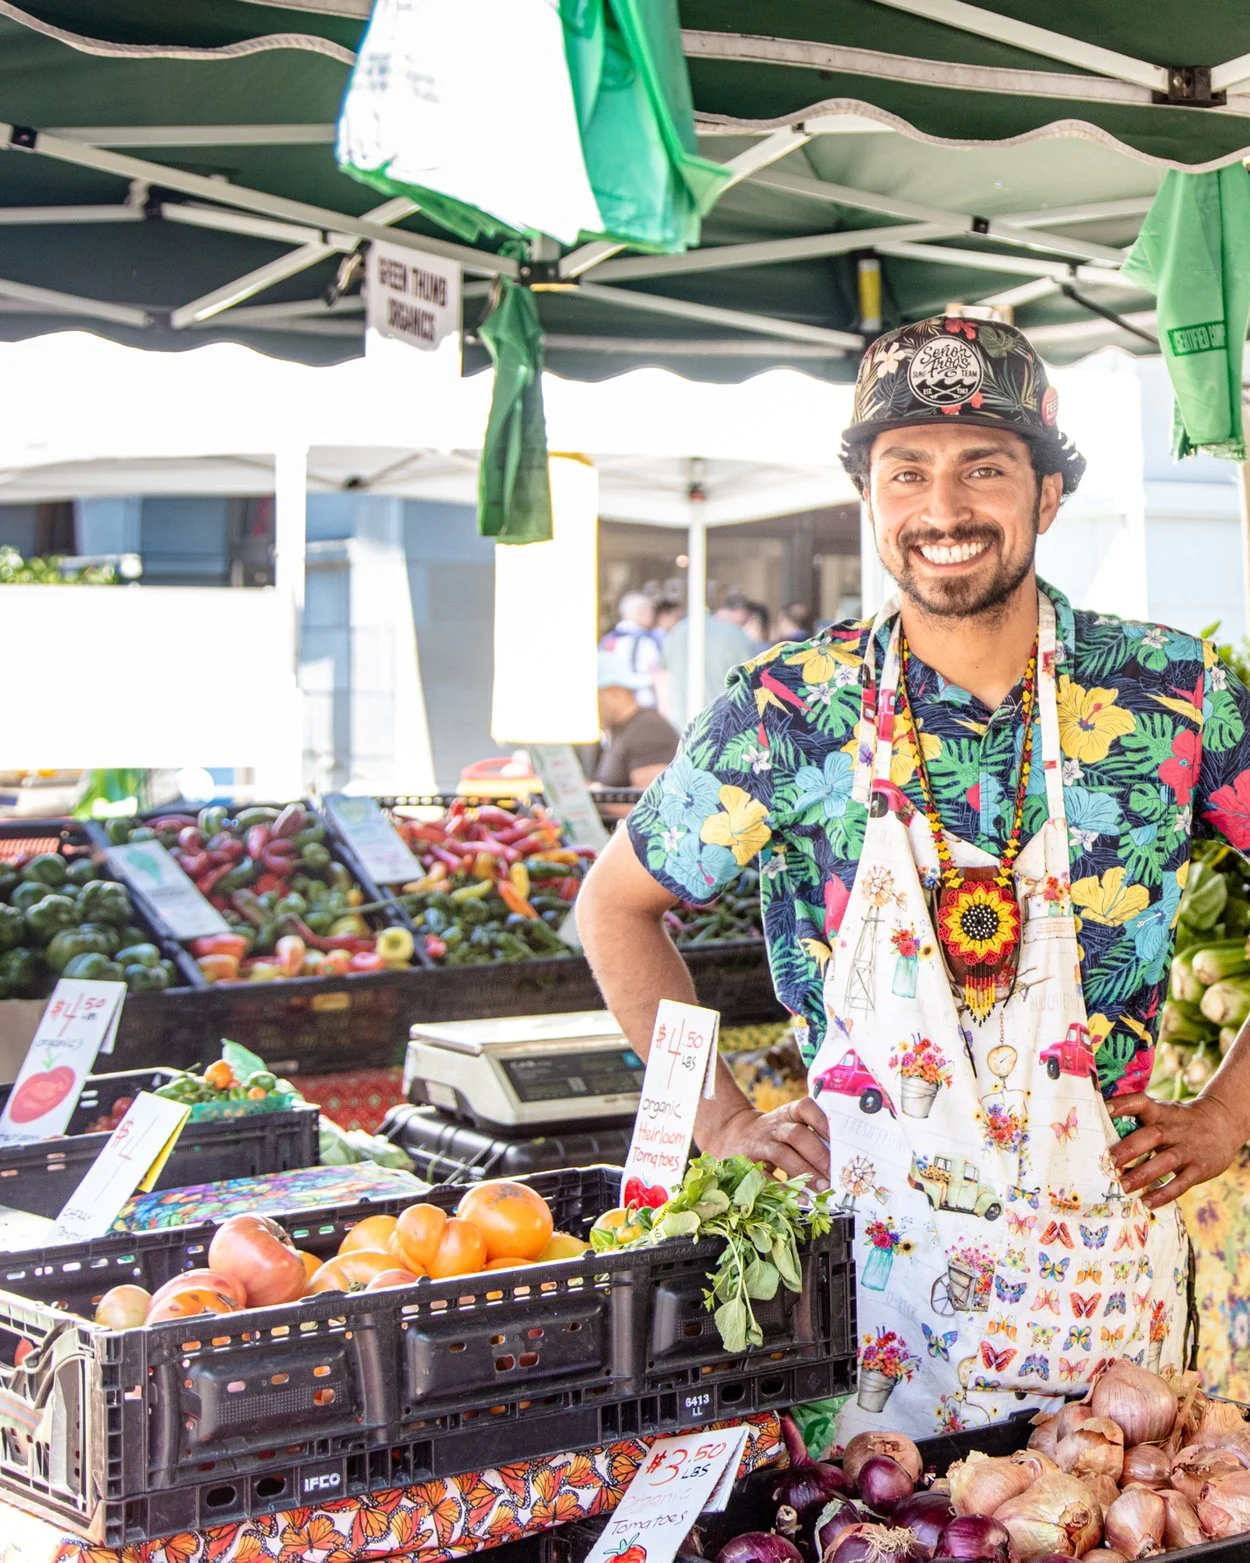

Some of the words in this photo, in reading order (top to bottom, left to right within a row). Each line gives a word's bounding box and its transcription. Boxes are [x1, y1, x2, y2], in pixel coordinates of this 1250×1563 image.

[411, 266, 449, 308] THUMB
[961, 369, 978, 378] TEAM
[642, 1098, 683, 1120] organic
[638, 1121, 687, 1150] Heirloom
[632, 1146, 681, 1173] Tomatoes
[685, 1393, 710, 1408] 6413
[692, 1406, 703, 1417] LL
[681, 1463, 711, 1479] LBS
[304, 1472, 341, 1492] IFCO
[611, 1510, 689, 1536] Tomatoes
